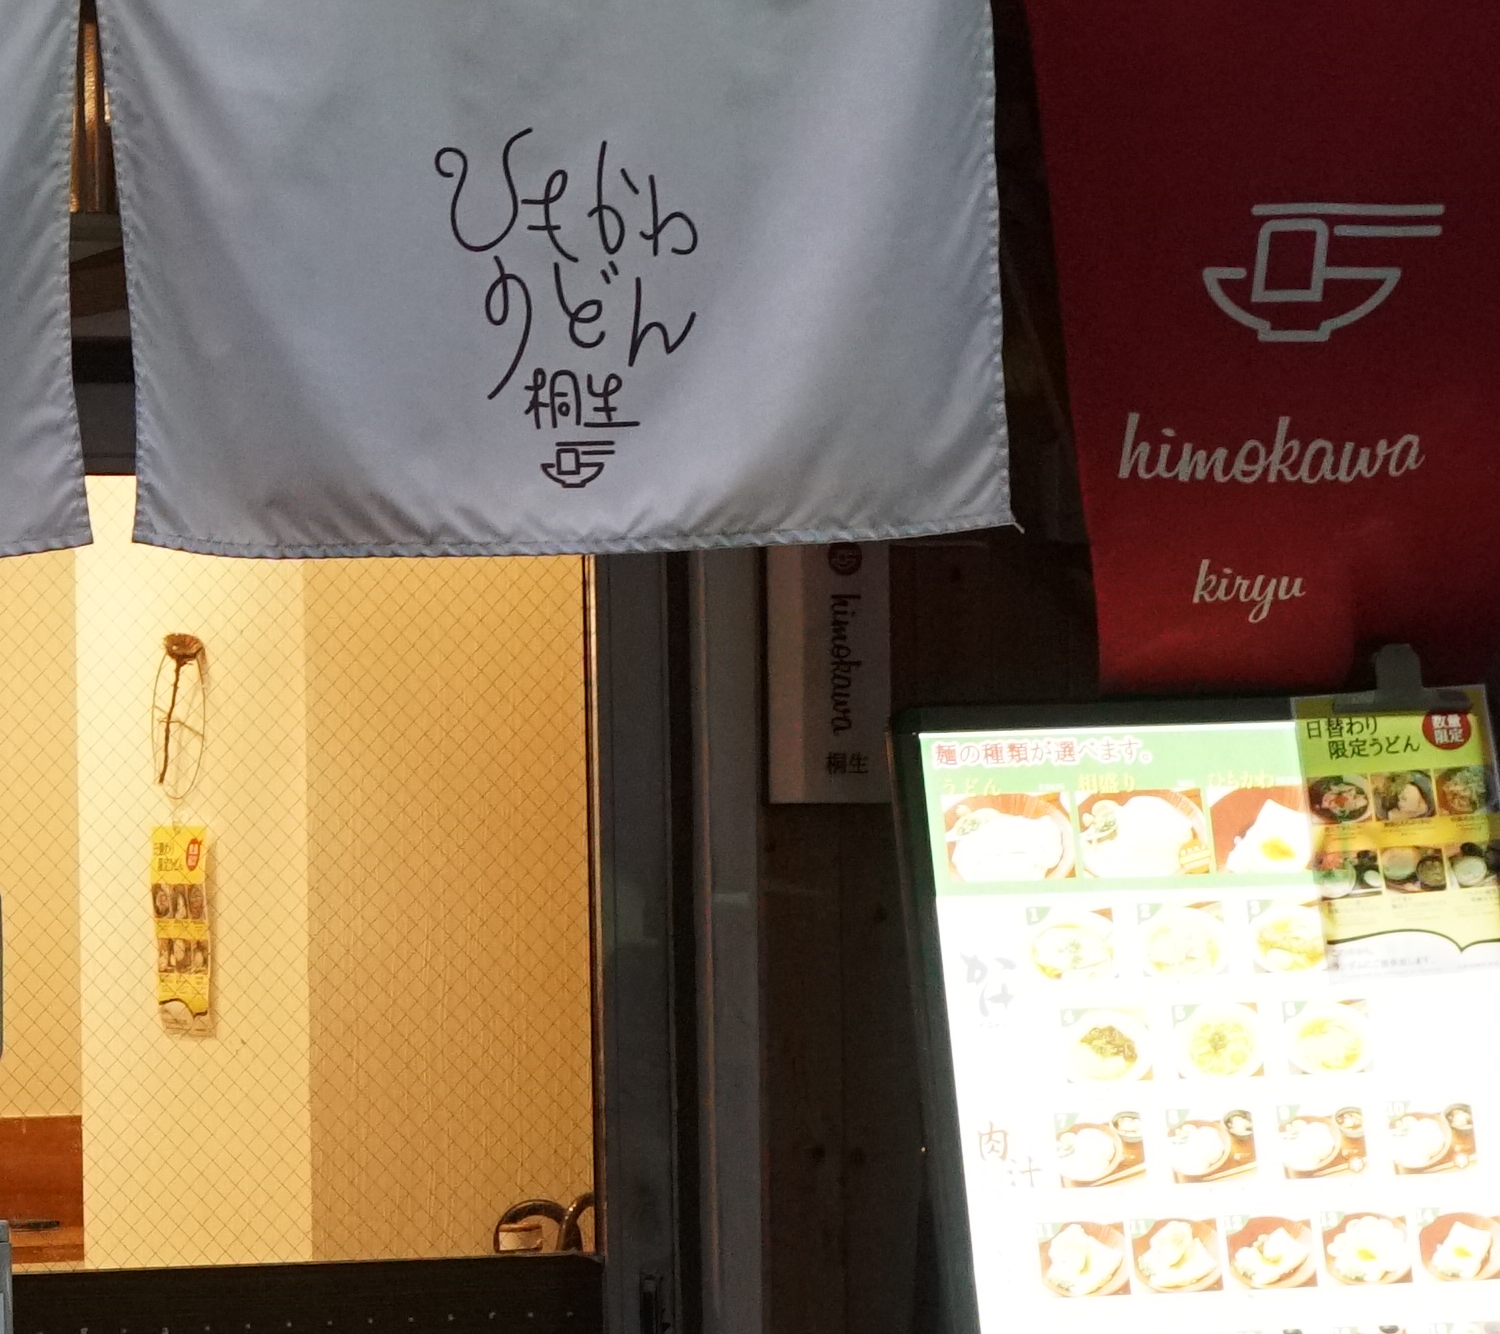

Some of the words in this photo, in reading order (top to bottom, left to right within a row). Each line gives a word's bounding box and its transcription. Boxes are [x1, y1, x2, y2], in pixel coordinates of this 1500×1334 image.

[435, 128, 699, 263] ひもかわ
[484, 254, 698, 400] うどん
[524, 366, 641, 430] 桐生
[1117, 412, 1426, 485] himokawa
[1191, 558, 1307, 624] kiryu
[831, 594, 862, 734] himokawa
[1306, 717, 1378, 739] 日替わり
[1328, 735, 1420, 760] 限定うどん
[1434, 728, 1465, 744] 限定
[1078, 773, 1136, 794] 相盛り
